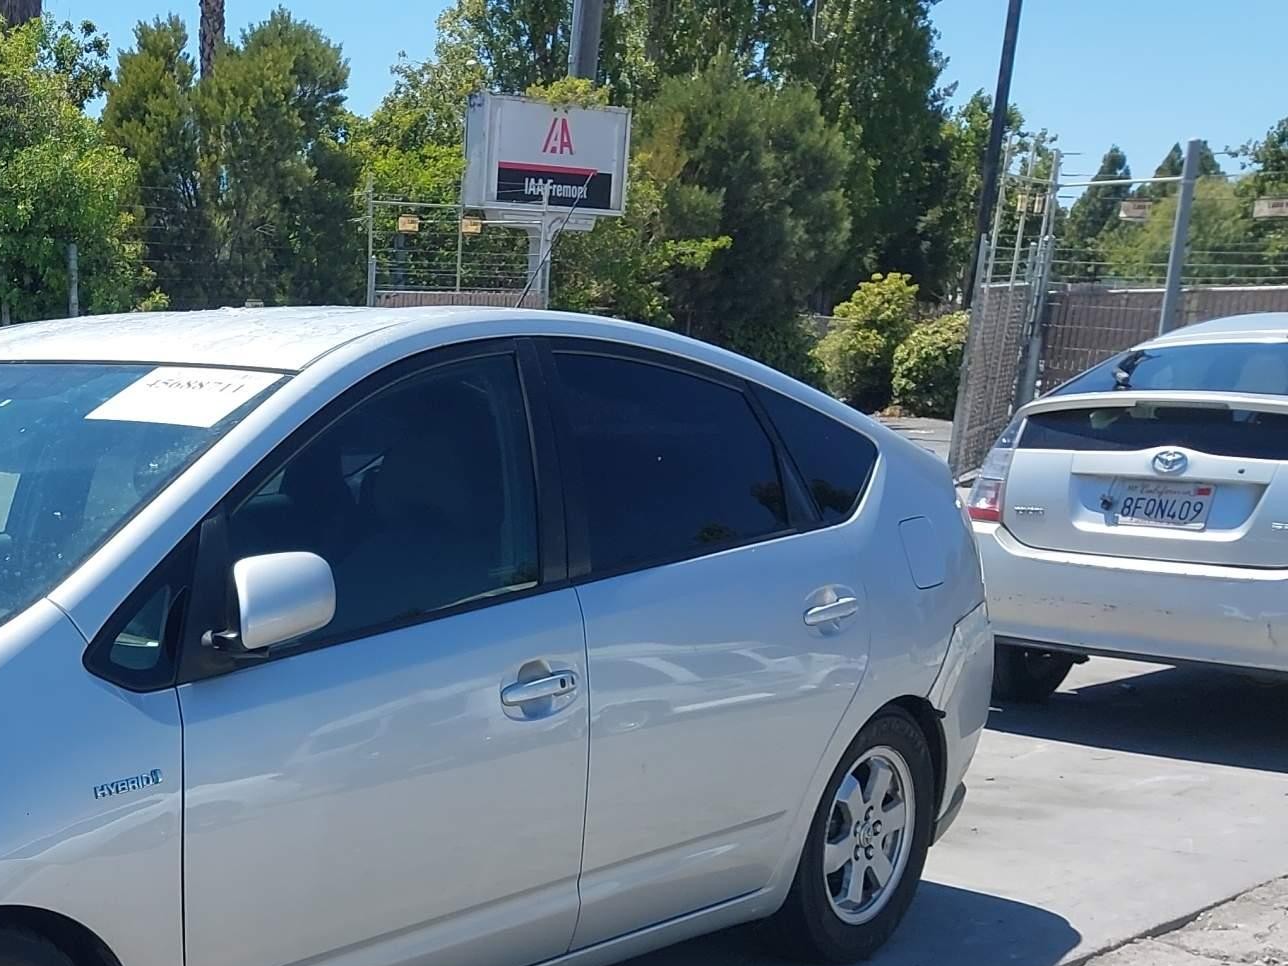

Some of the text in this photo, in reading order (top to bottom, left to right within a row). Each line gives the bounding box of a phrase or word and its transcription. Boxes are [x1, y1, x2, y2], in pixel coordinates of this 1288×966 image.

[524, 177, 588, 199] IAA Fremont
[1120, 497, 1204, 521] 8FQN409
[93, 774, 153, 799] HYBRID
